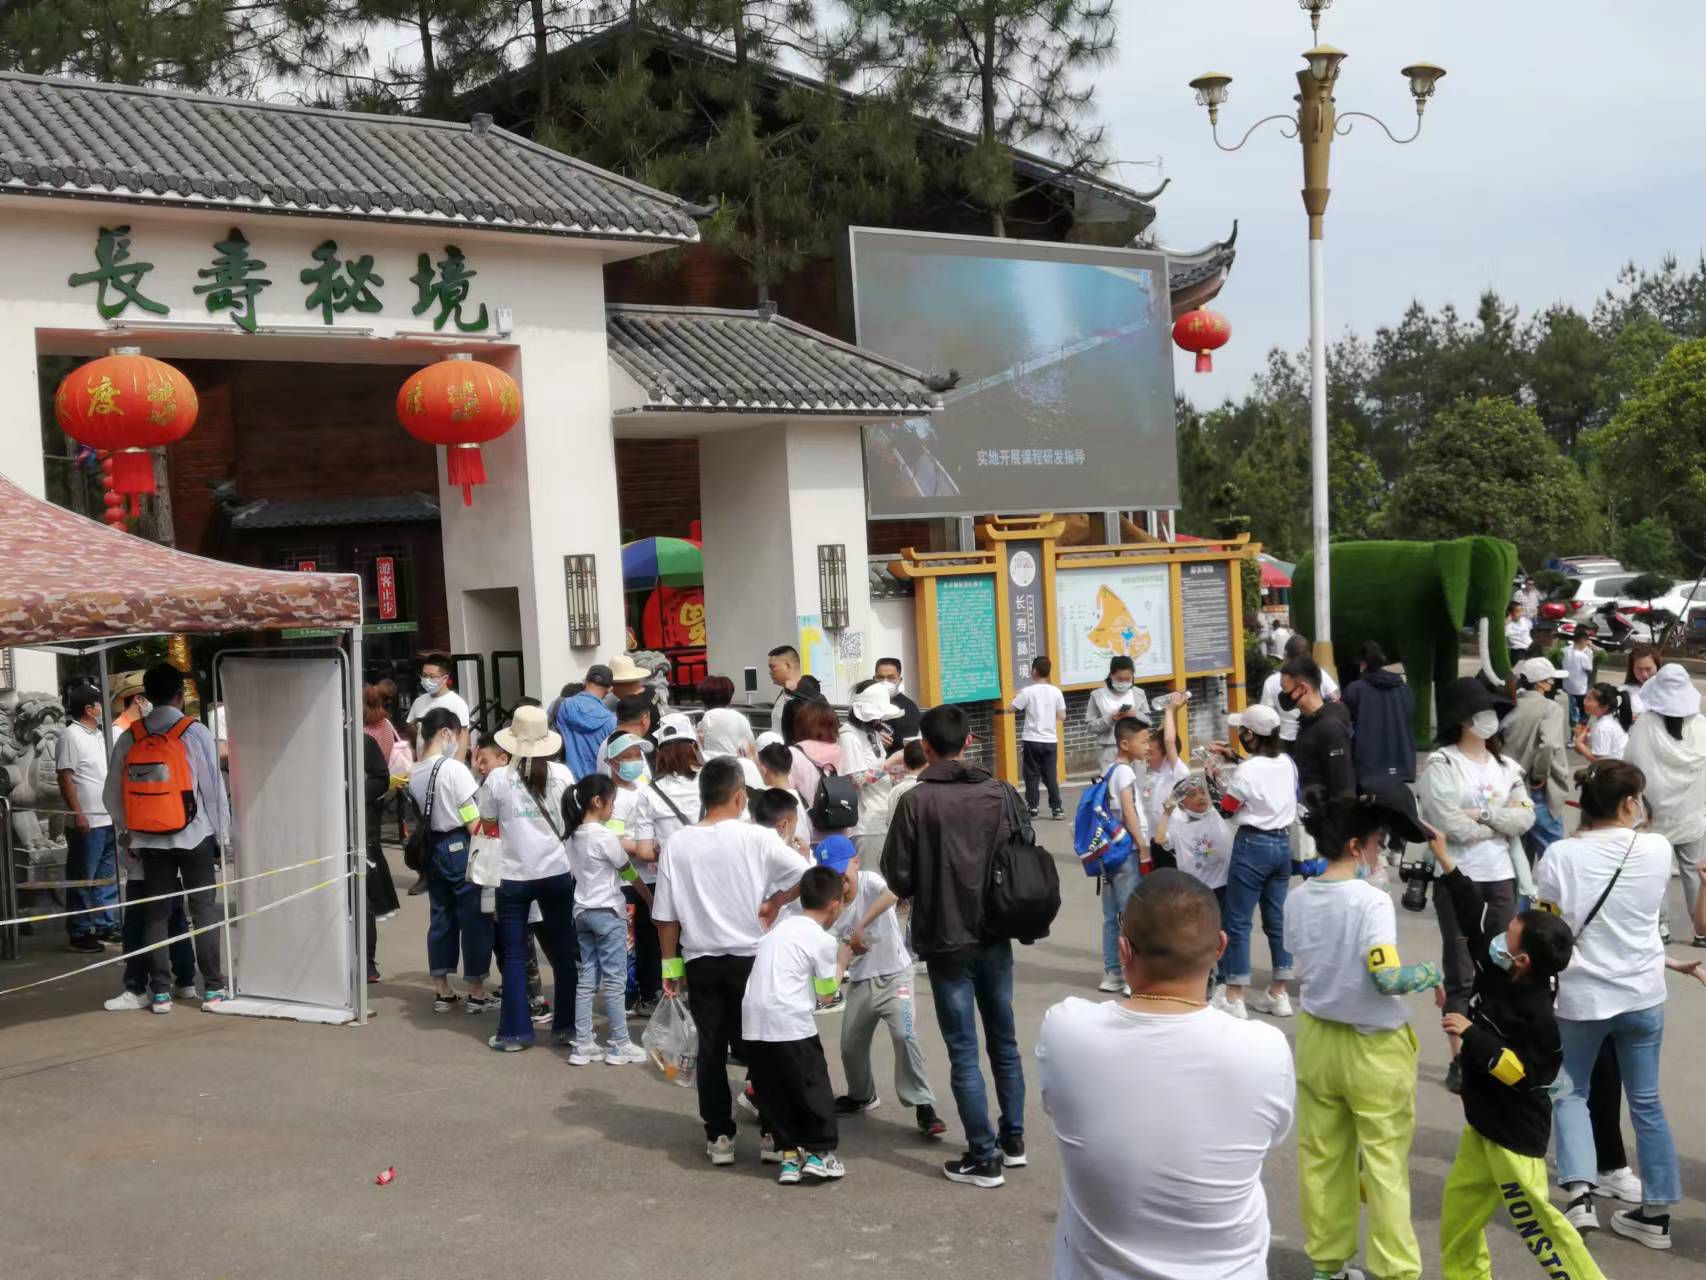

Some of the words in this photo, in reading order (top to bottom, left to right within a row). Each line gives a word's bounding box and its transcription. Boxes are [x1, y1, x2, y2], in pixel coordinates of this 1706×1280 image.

[976, 448, 1086, 466] 实地开展课程研发指导
[379, 563, 393, 613] 游客止步
